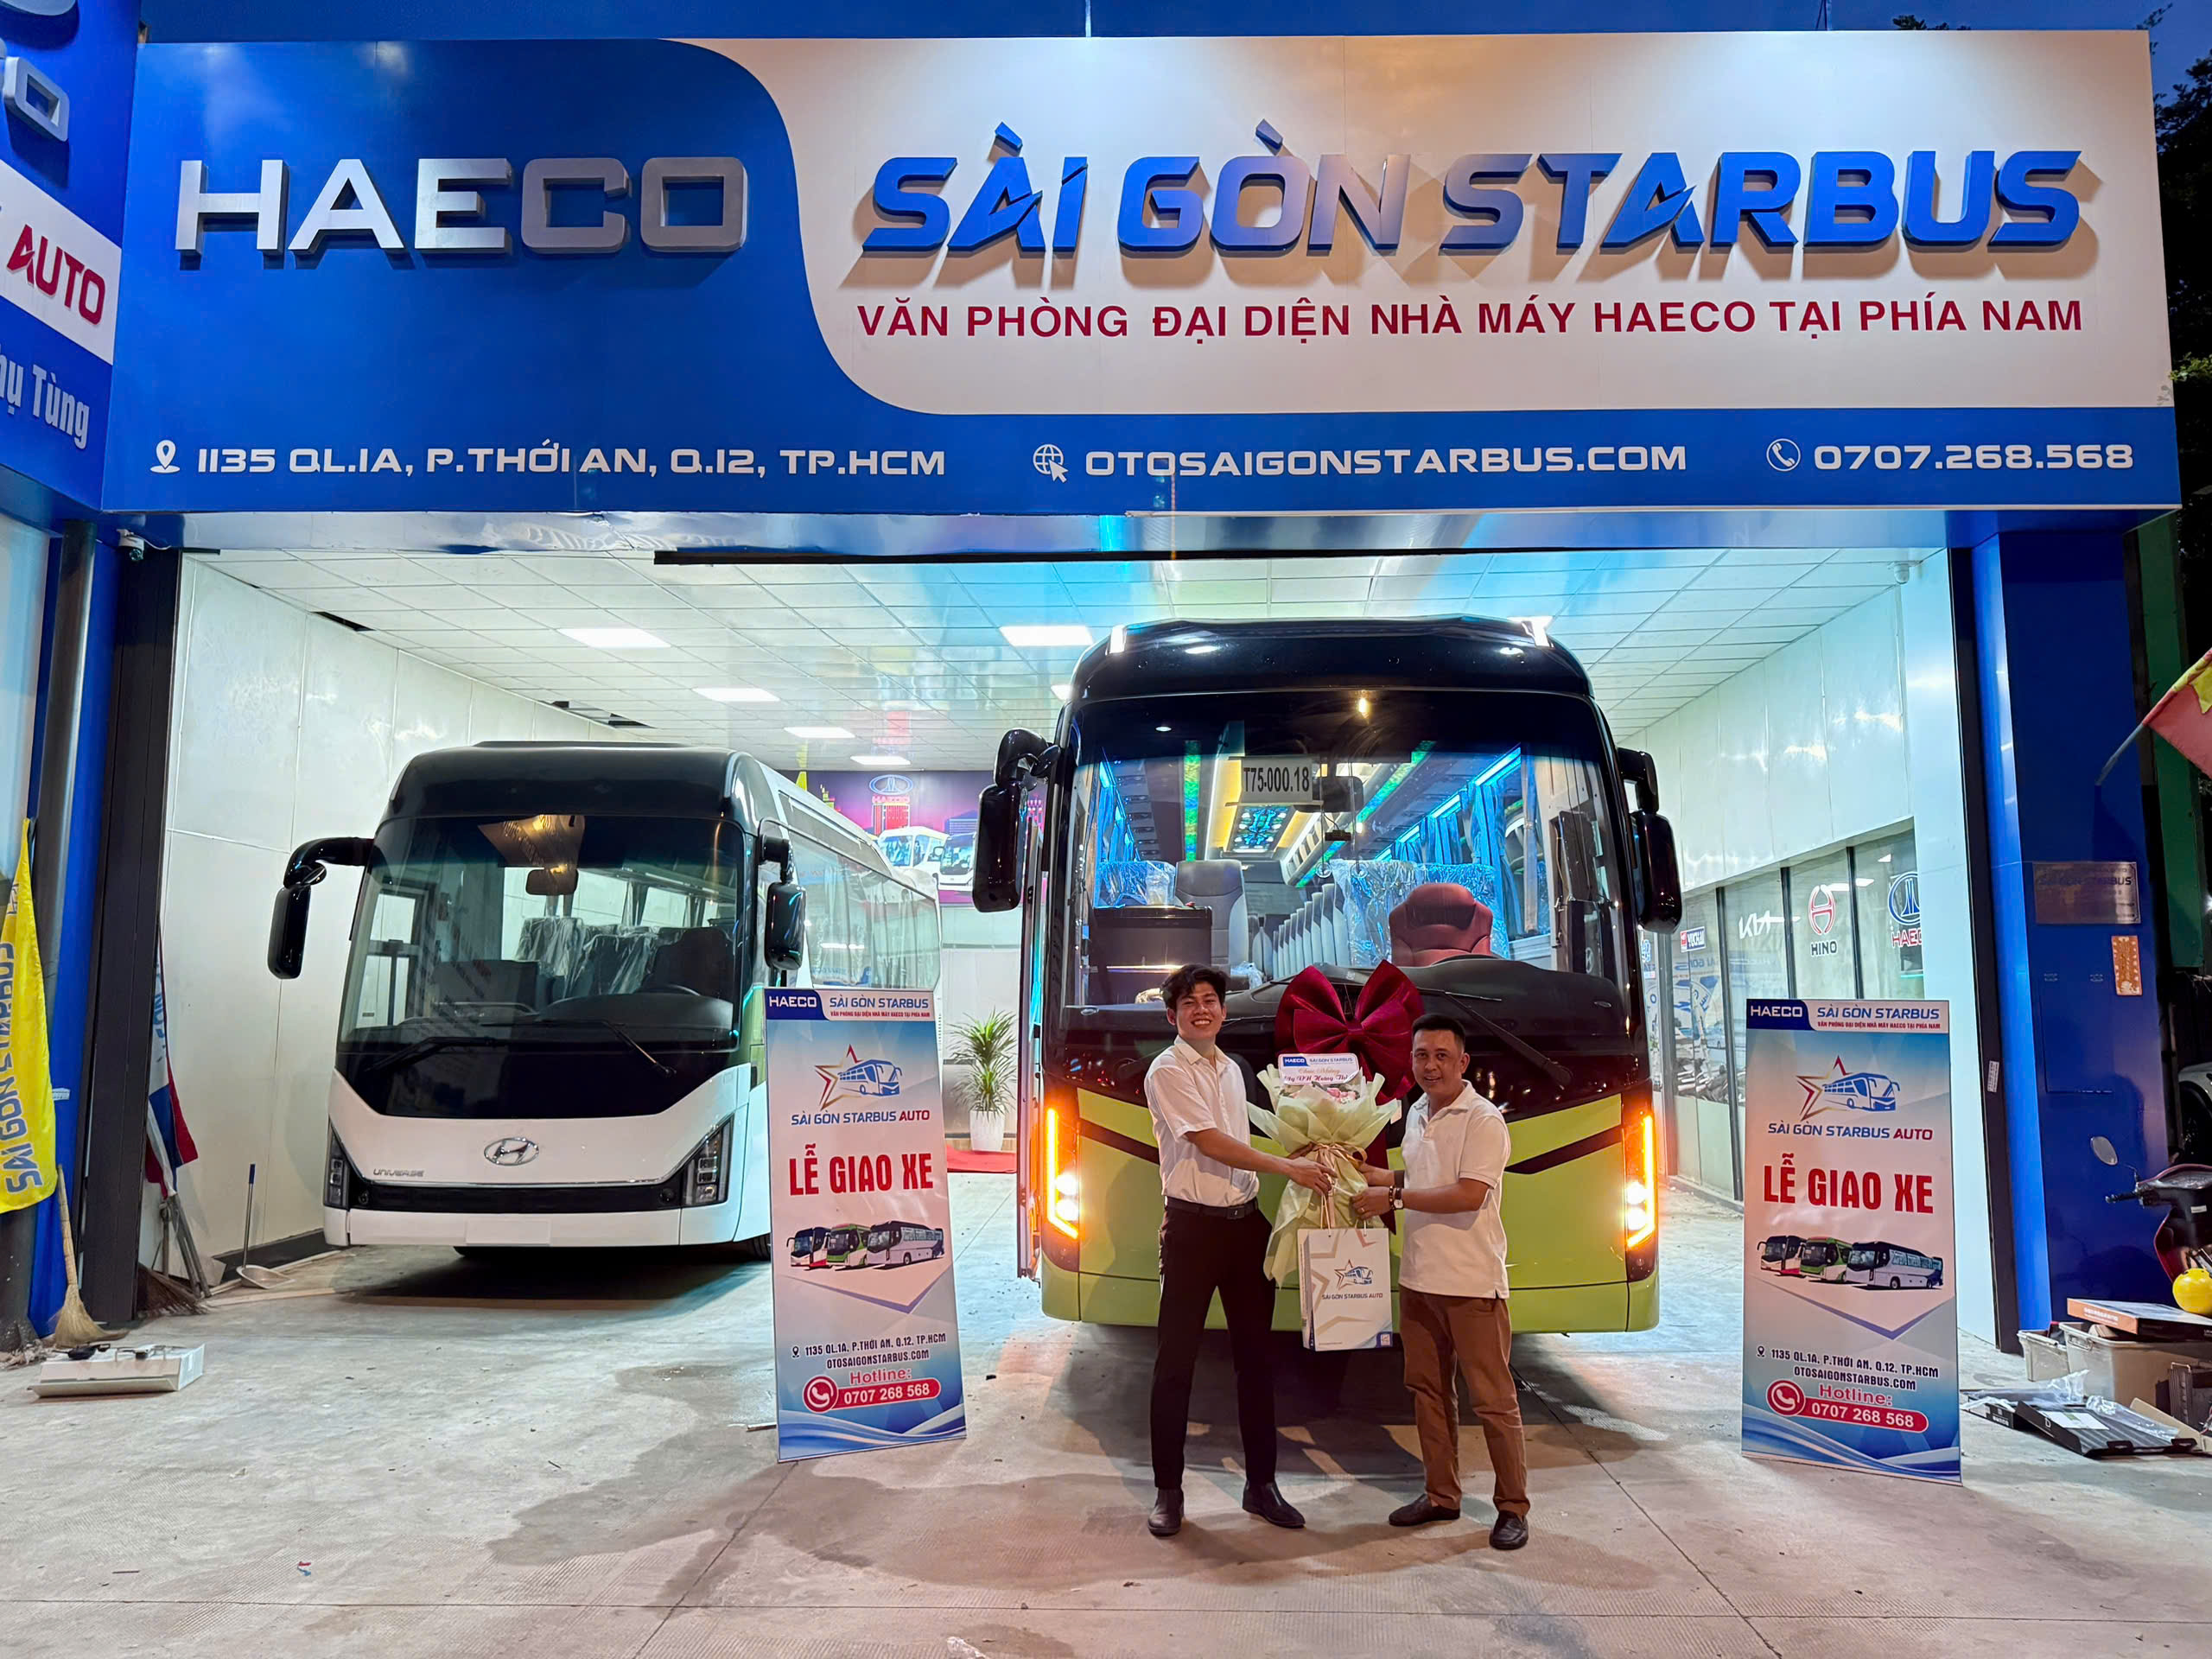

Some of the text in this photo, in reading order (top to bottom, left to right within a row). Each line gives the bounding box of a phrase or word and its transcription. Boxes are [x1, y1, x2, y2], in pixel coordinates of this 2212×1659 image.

[862, 118, 2082, 251] SÀI GÒN STARBUS
[175, 156, 748, 254] HAECO
[7, 224, 105, 326] AUTO
[858, 291, 2082, 345] VĂN PHÒNG ĐẠI DIỆN NHÀ MÁY HAECO TẠI PHÍA NAM
[33, 365, 90, 449] Tùng
[199, 448, 276, 473] 1135
[427, 439, 570, 473] P.THỚI
[578, 448, 658, 476] AN,
[671, 448, 765, 476] Q.12,
[782, 450, 945, 474] TP.HCM
[1086, 445, 1687, 476] OTOSAIGONSTARBUS.COM
[1814, 444, 2133, 470] 0707.268.568
[1811, 941, 1837, 956] HINO
[769, 996, 817, 1007] HAECO
[830, 995, 929, 1008] SÀI GÒN STARBUS
[1751, 1006, 1802, 1018] HAECO
[1817, 1004, 1939, 1020] SÀI GÒN STARBUS
[791, 1109, 930, 1125] SÀI GÒN STARBUS AUTO
[1768, 1120, 1933, 1141] SÀI GÒN STARBUS AUTO
[790, 1143, 933, 1196] LỄ GIAO XE
[1764, 1153, 1934, 1214] LỄ GIAO XE
[805, 1345, 823, 1356] 1135
[917, 1333, 946, 1345] TP.HCM
[826, 1350, 930, 1369] OTOSAIGONSTARBUS.COM
[1771, 1350, 1790, 1360] 1135
[1901, 1364, 1939, 1378] TP.HCM
[849, 1369, 912, 1385] Hotline:
[1794, 1367, 1916, 1390] OTOSAIGONSTARBUS.COM
[844, 1383, 931, 1404] 0707 268 568
[1819, 1384, 1892, 1407] Hotline:
[1811, 1402, 1914, 1427] 0707 268 568
